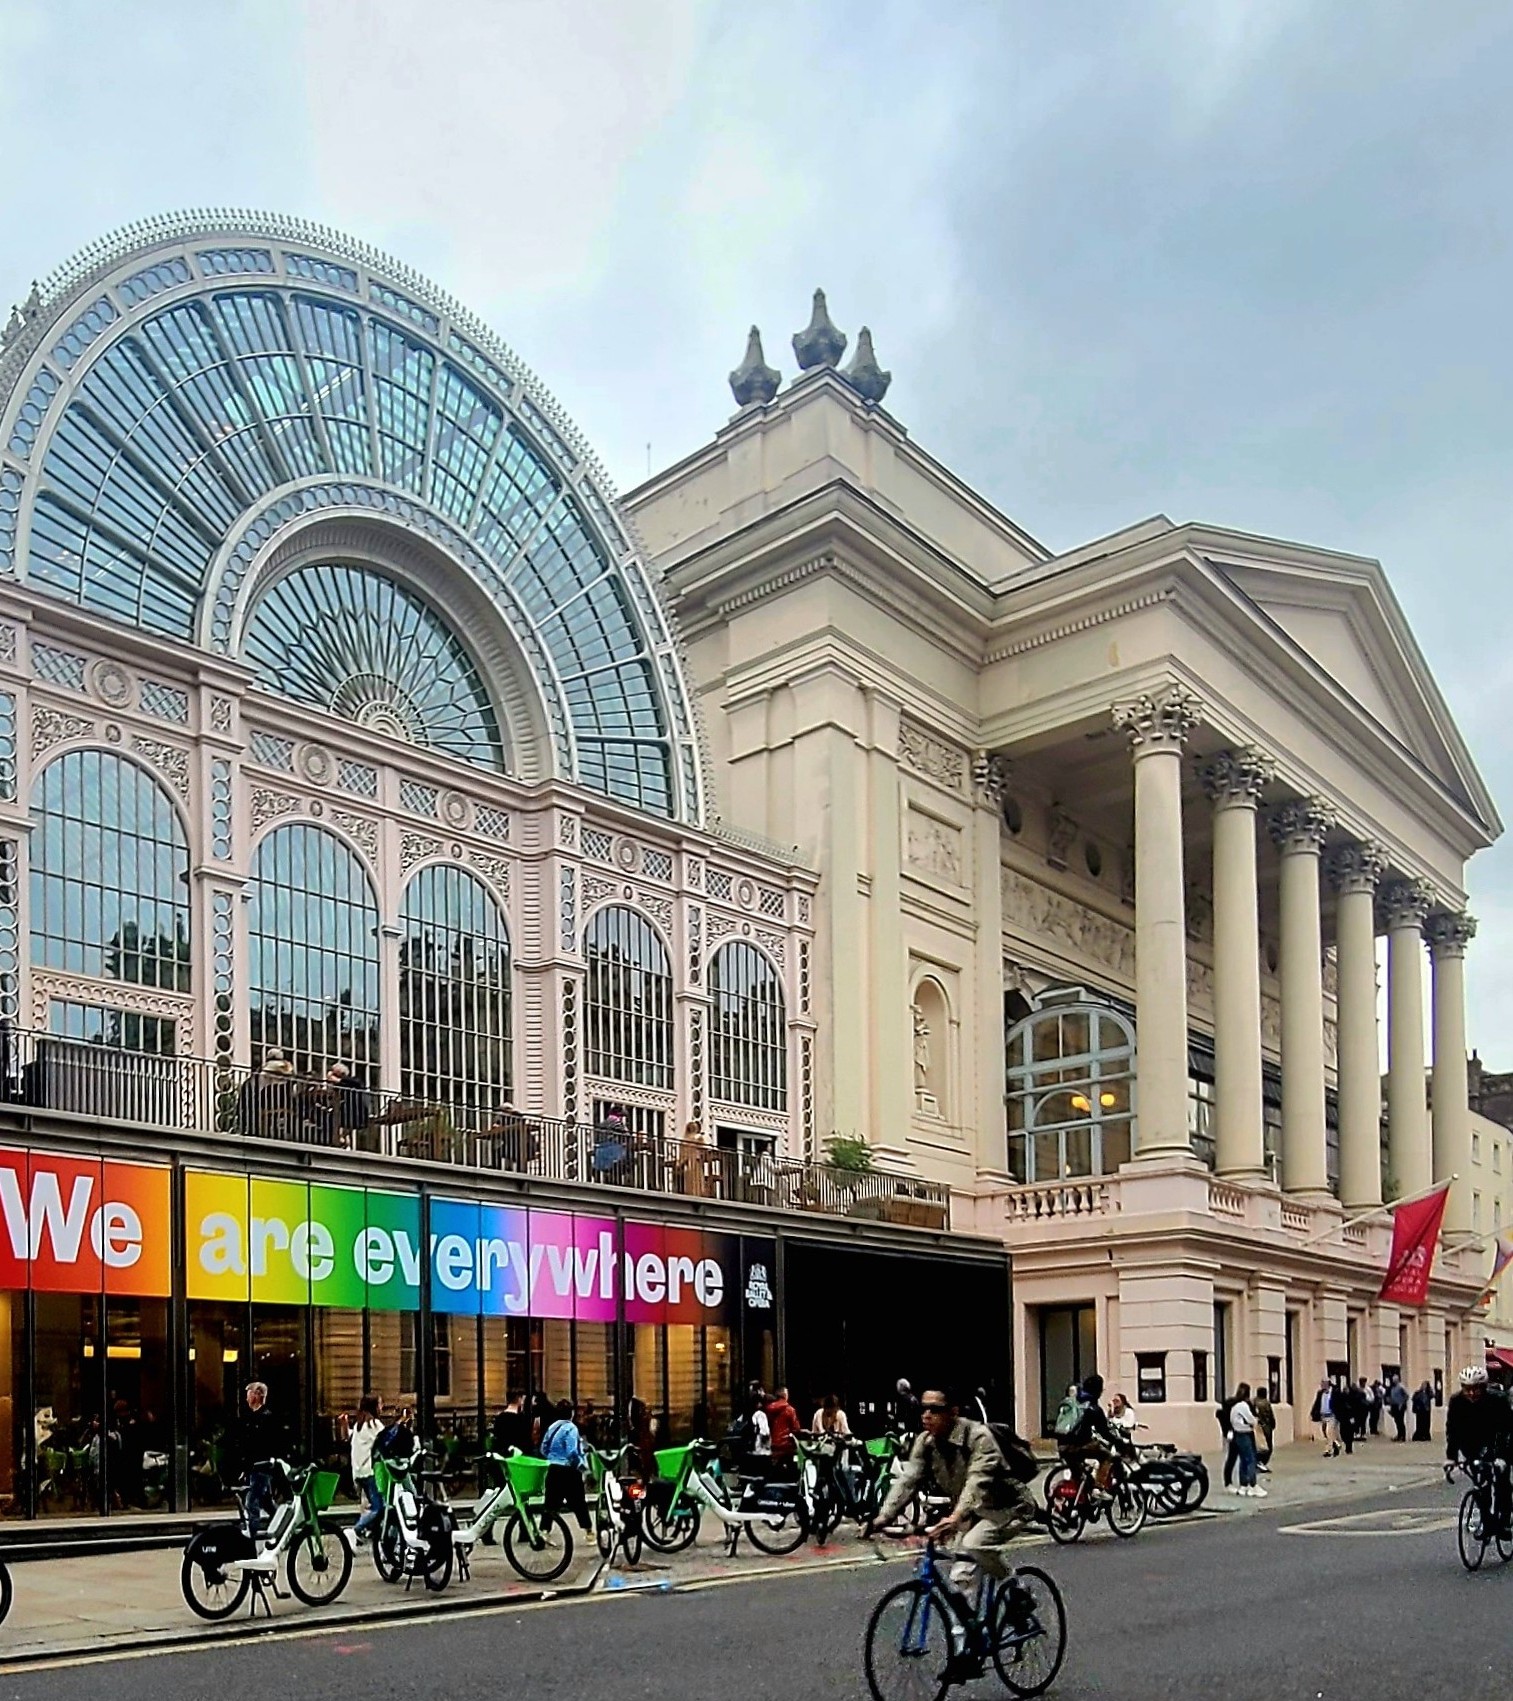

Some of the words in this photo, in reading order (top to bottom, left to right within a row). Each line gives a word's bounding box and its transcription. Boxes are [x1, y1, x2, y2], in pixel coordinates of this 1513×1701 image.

[0, 1168, 142, 1268] We
[199, 1212, 335, 1282] are
[353, 1226, 724, 1312] everywhere
